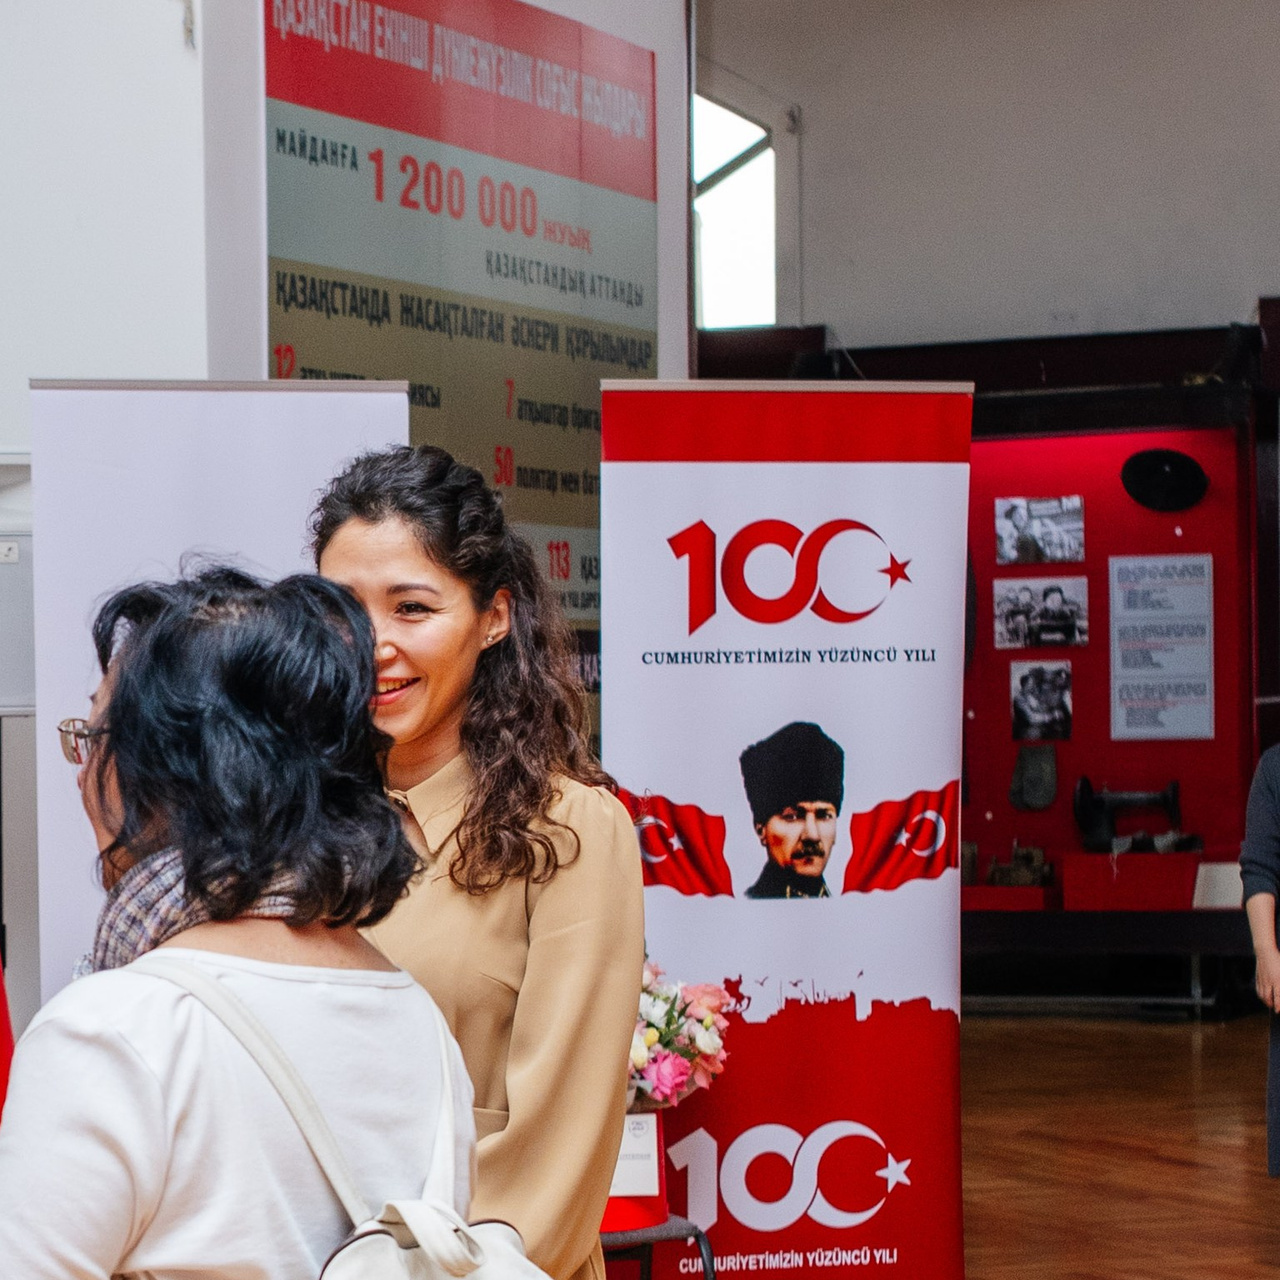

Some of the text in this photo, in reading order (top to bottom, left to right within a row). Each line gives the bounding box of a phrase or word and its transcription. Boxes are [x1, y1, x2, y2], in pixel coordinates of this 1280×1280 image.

[368, 148, 384, 202] 1
[399, 154, 466, 220] 200
[478, 175, 537, 237] 000
[642, 647, 937, 665] CUMHURİYETİMİZİN YÜZÜNCÜ YILI
[806, 1246, 870, 1267] YÜZÜNCÜ
[873, 1247, 898, 1264] YILI
